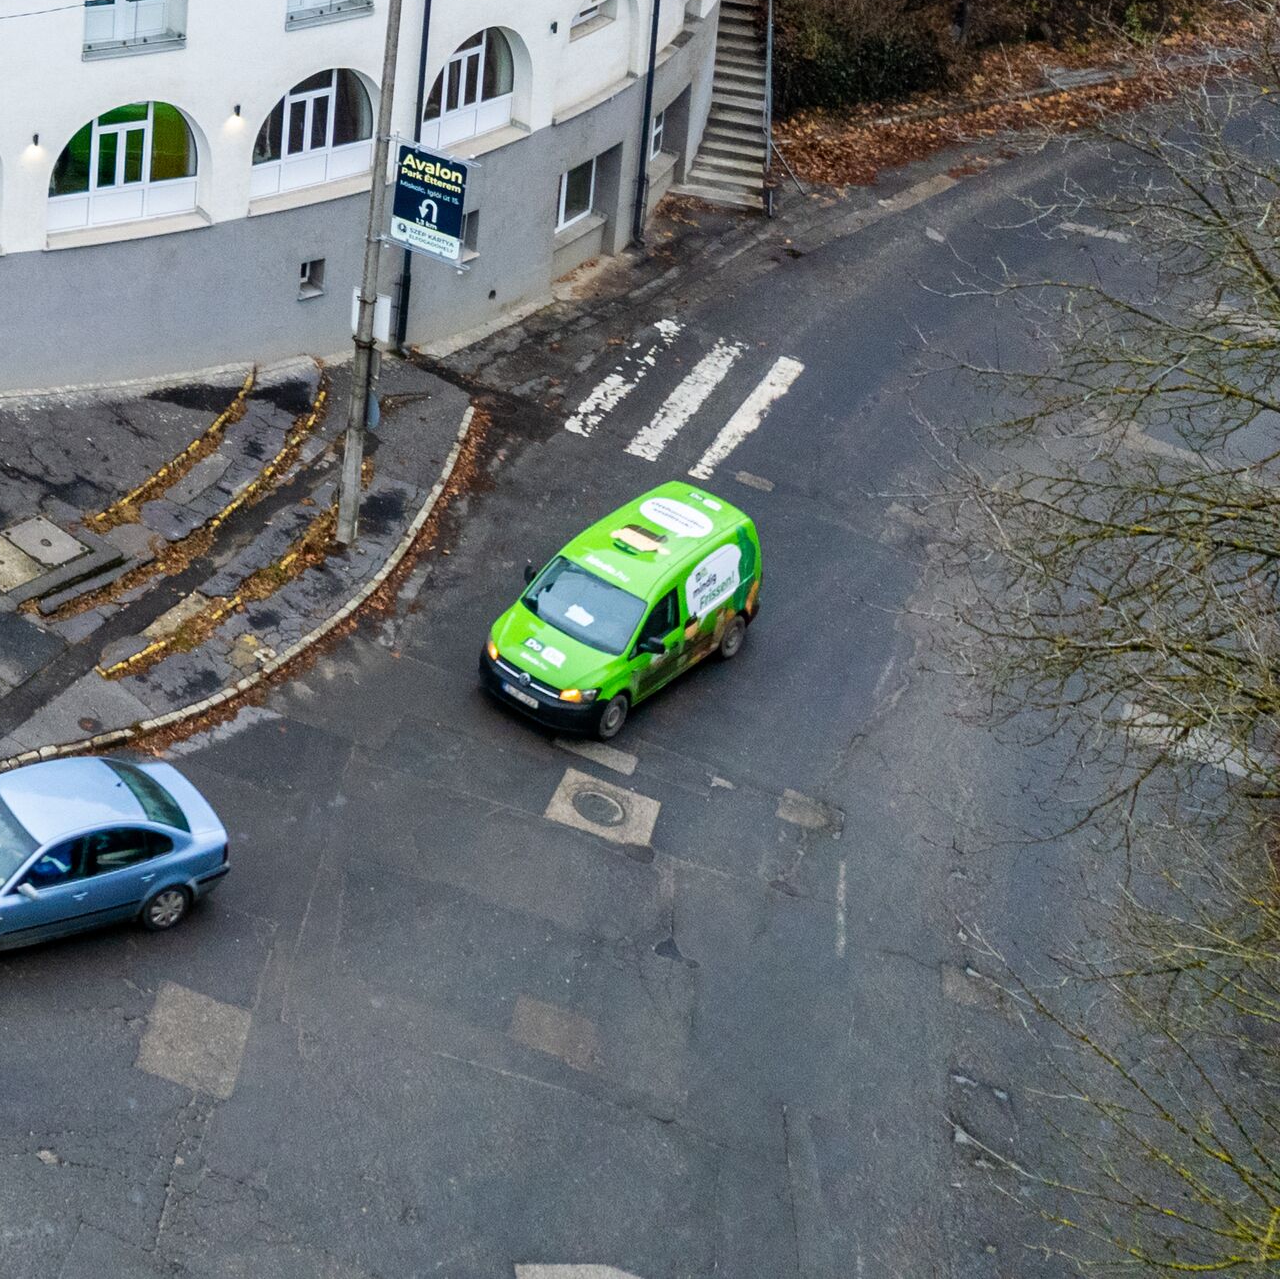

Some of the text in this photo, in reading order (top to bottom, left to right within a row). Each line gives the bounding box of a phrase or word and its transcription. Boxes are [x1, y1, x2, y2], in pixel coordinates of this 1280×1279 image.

[401, 166, 462, 194] Park Étterem
[402, 153, 463, 184] Avalon
